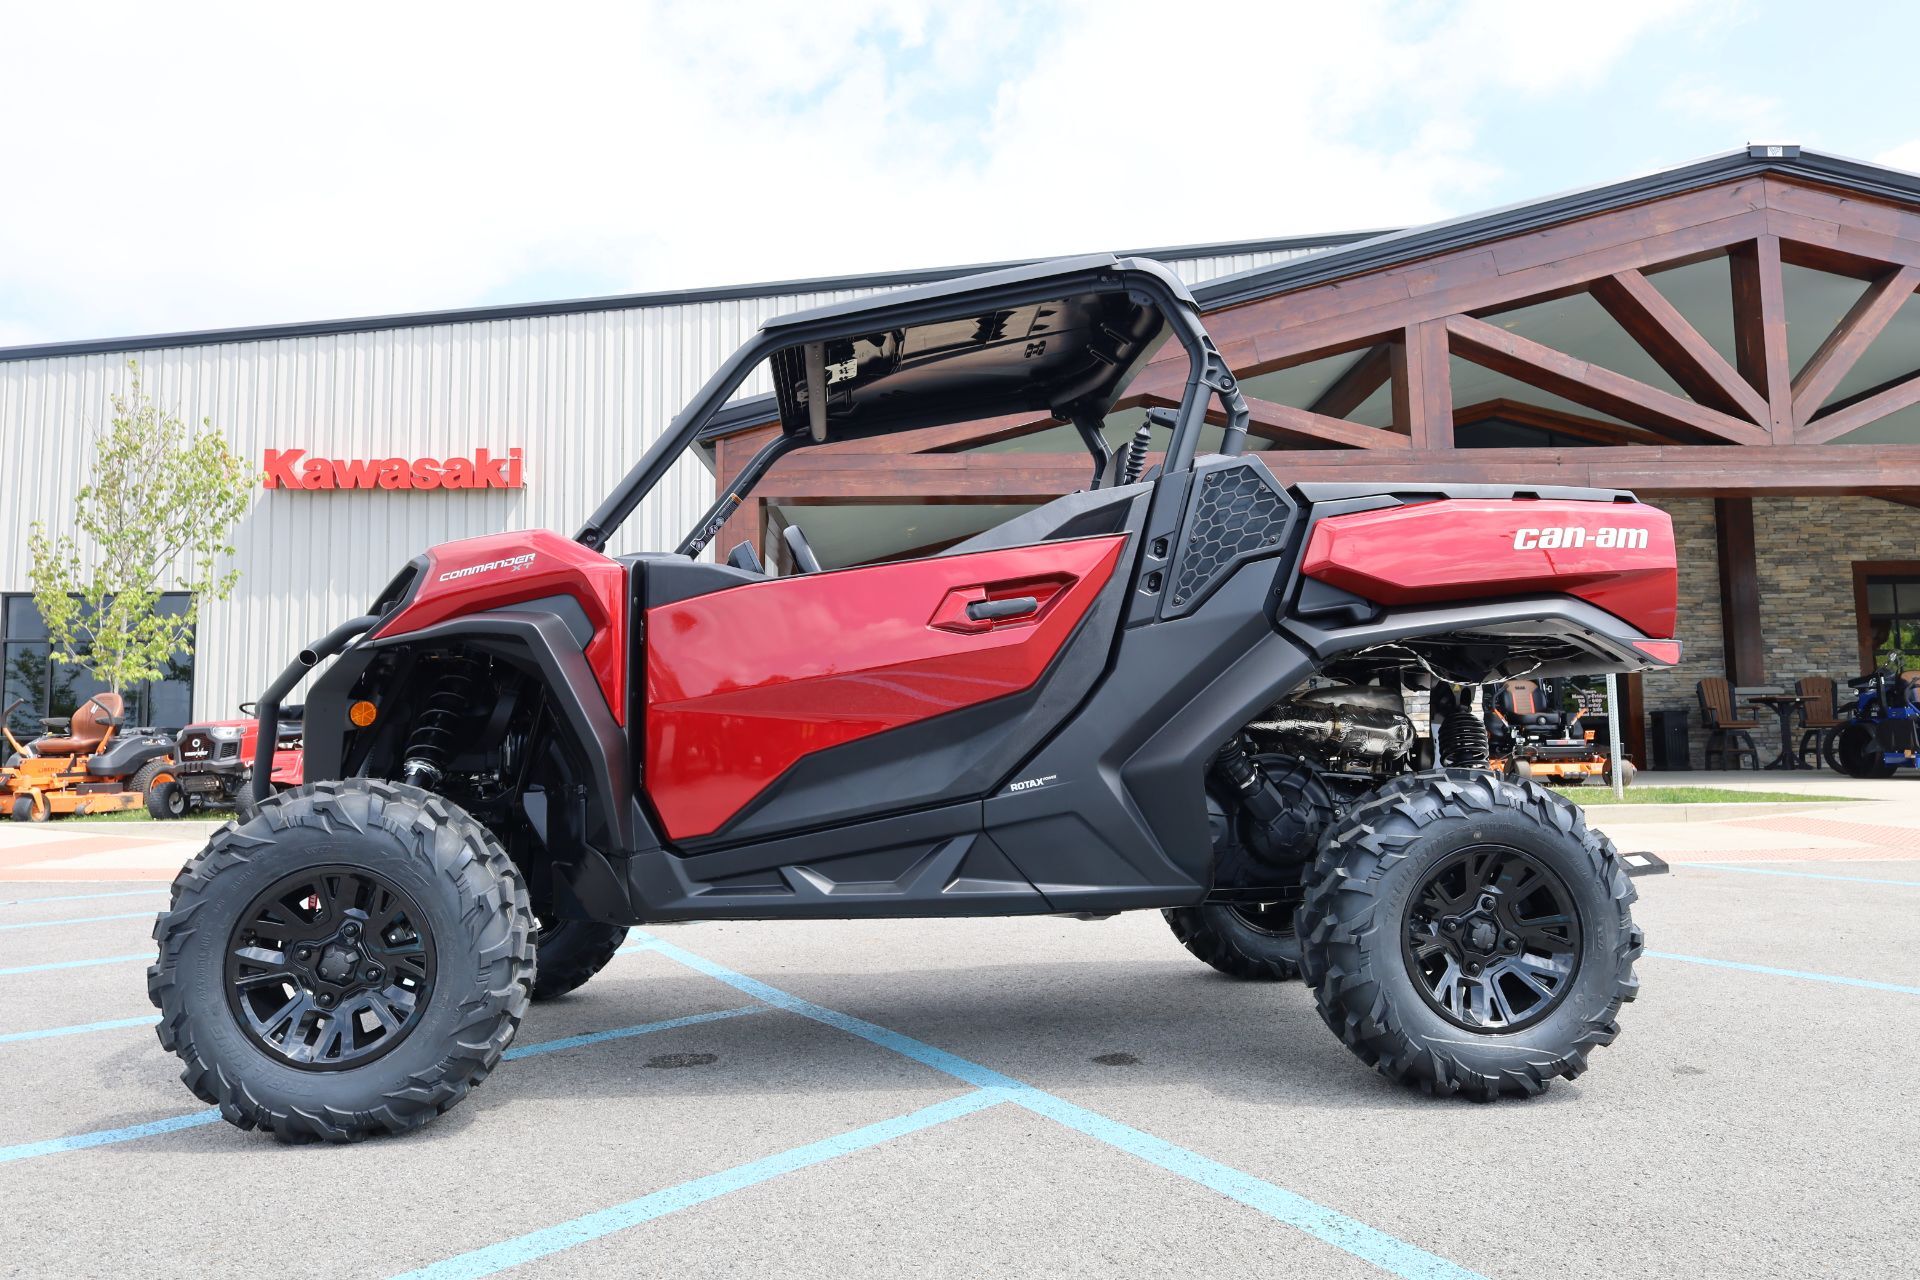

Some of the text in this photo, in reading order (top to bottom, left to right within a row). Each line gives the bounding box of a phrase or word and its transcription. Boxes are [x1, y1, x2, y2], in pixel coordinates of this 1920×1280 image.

[264, 448, 523, 490] Kawasaki
[439, 553, 536, 581] COMMANDER
[512, 562, 534, 572] XT
[1010, 778, 1044, 791] ROTAX
